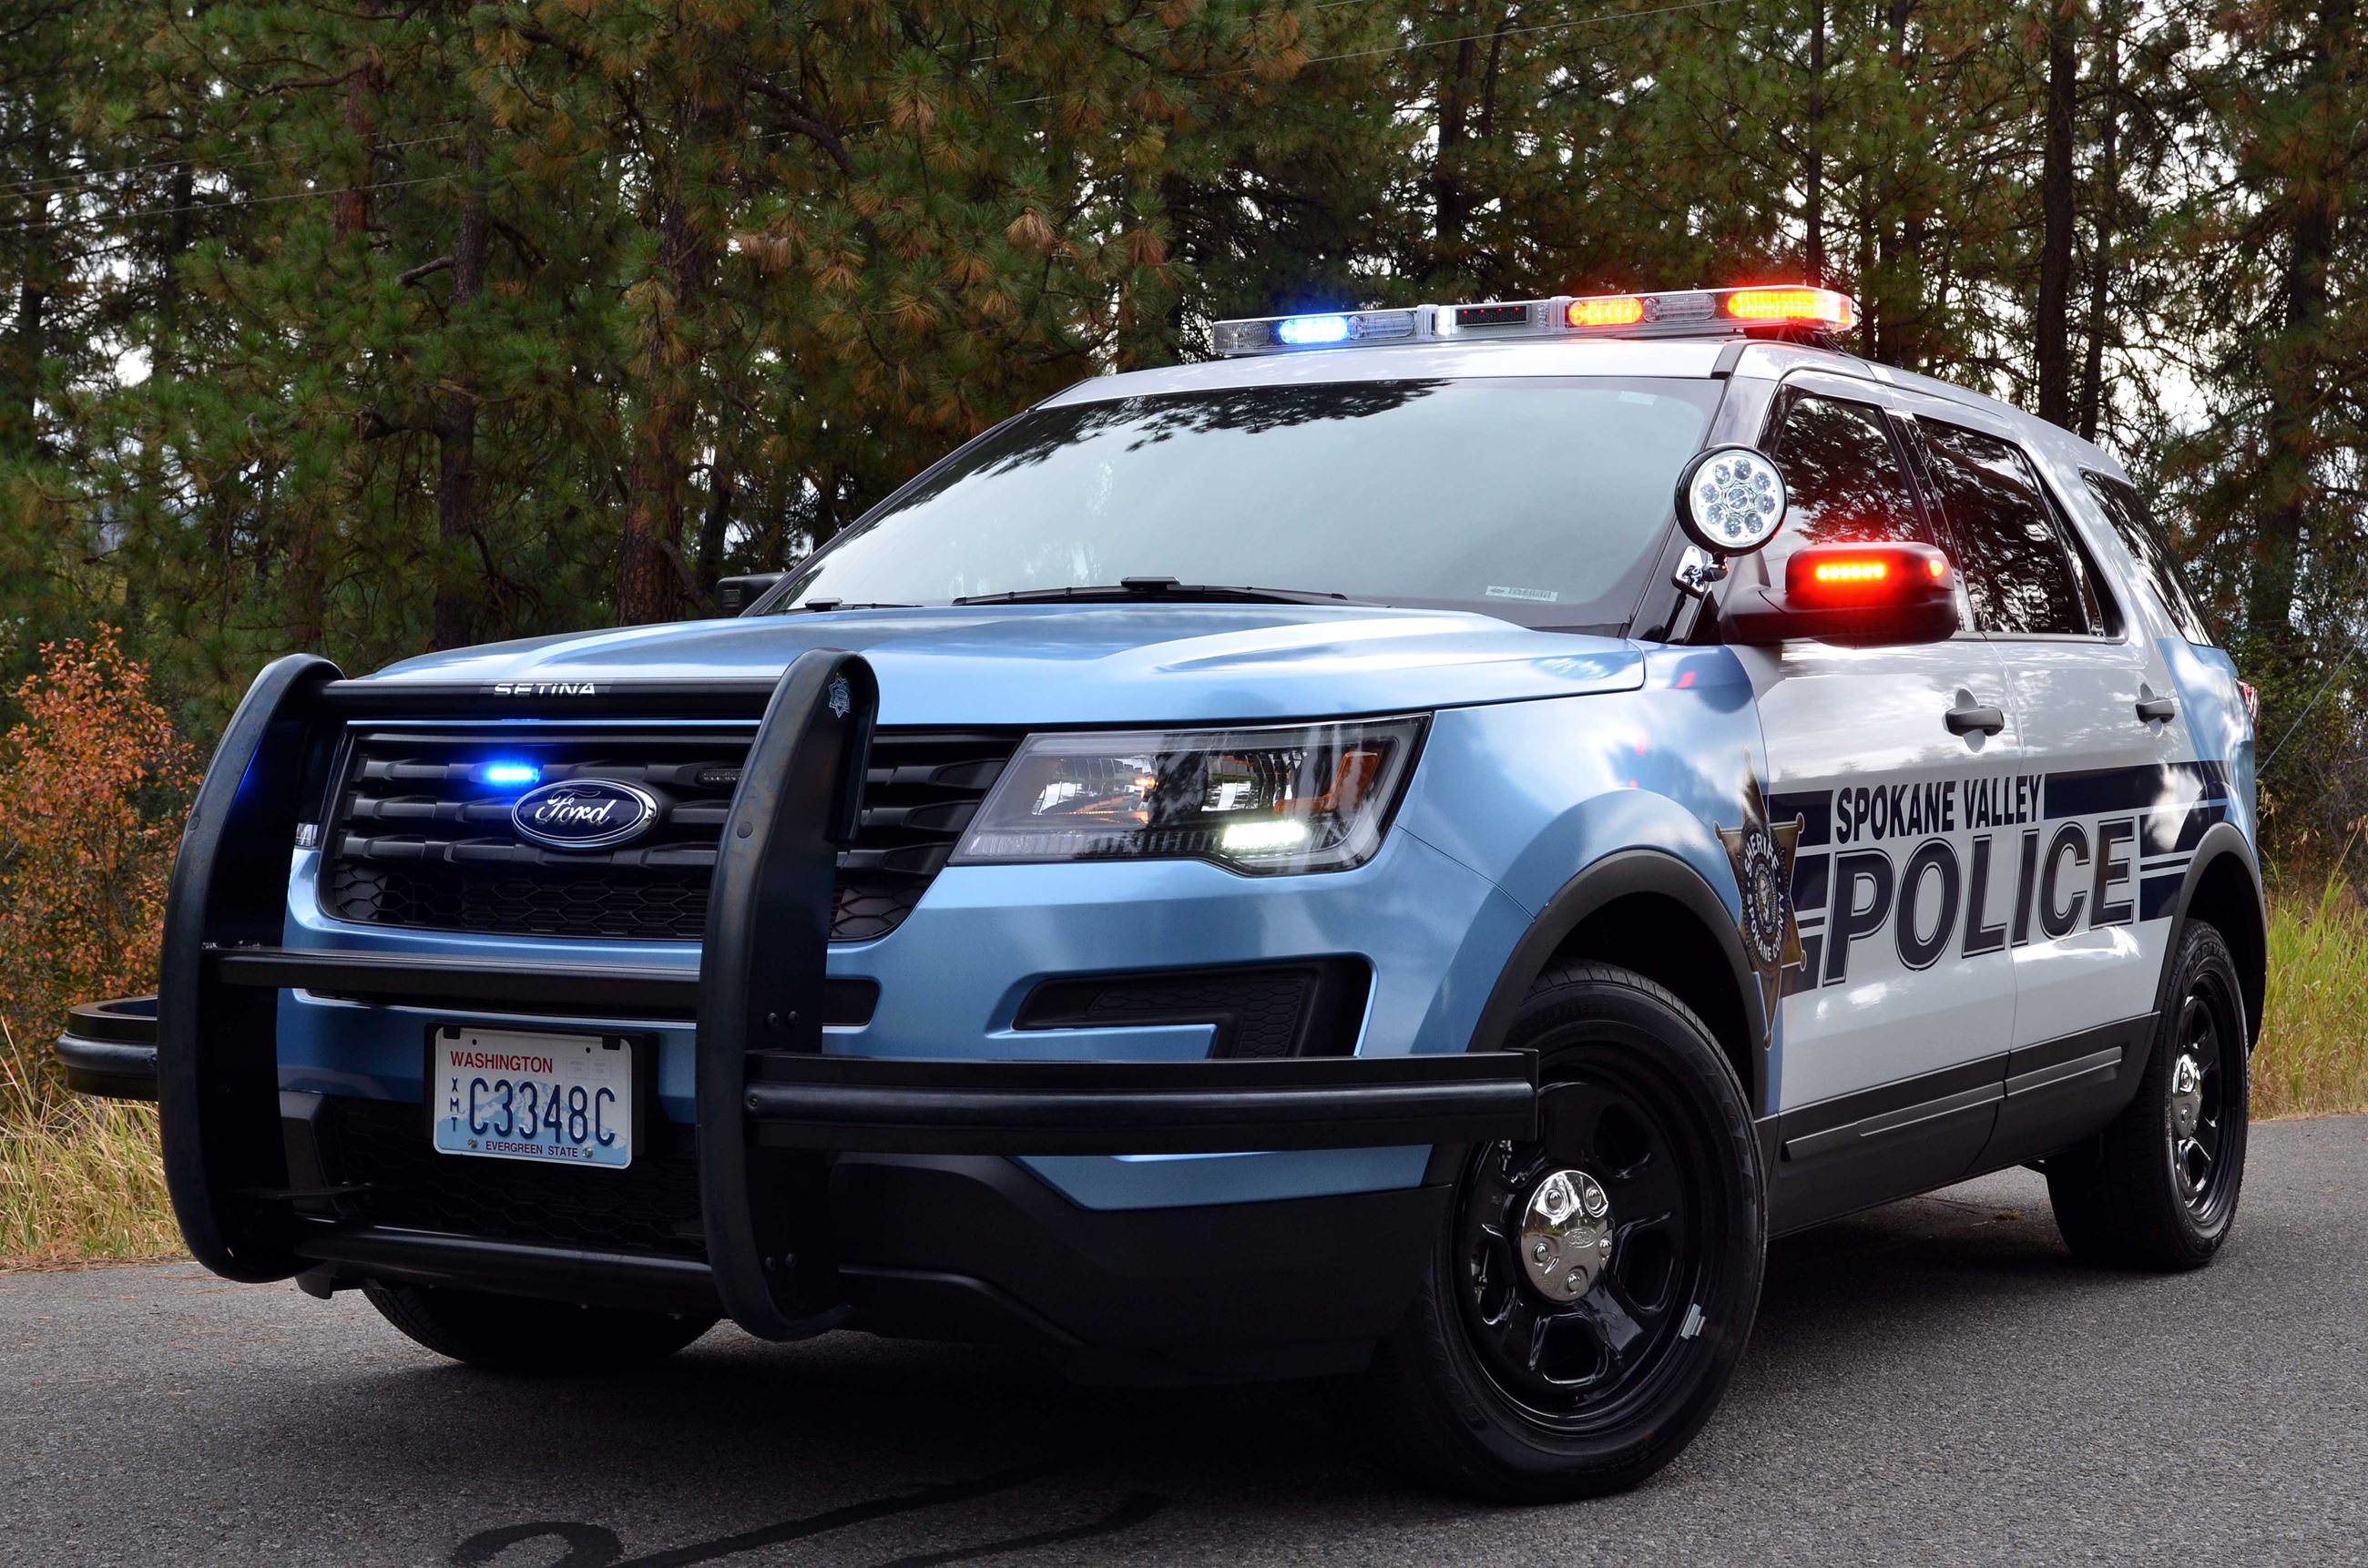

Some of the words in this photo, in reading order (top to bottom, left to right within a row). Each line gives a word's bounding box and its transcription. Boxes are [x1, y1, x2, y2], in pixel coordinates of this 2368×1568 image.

[494, 683, 596, 696] SETINA
[535, 789, 618, 825] Ford
[1836, 780, 1956, 845] SPOKANE
[1964, 774, 2043, 830] VALLEY
[1744, 832, 1780, 879] SHERIFF
[1822, 816, 2136, 988] POLICE
[1746, 892, 1772, 962] SPOKANE
[1772, 891, 1785, 959] COUNTY
[450, 1051, 554, 1074] WASHINGTON
[469, 1077, 616, 1146] C3348C
[485, 1140, 543, 1155] EVERGREEN
[548, 1145, 578, 1157] STATE
